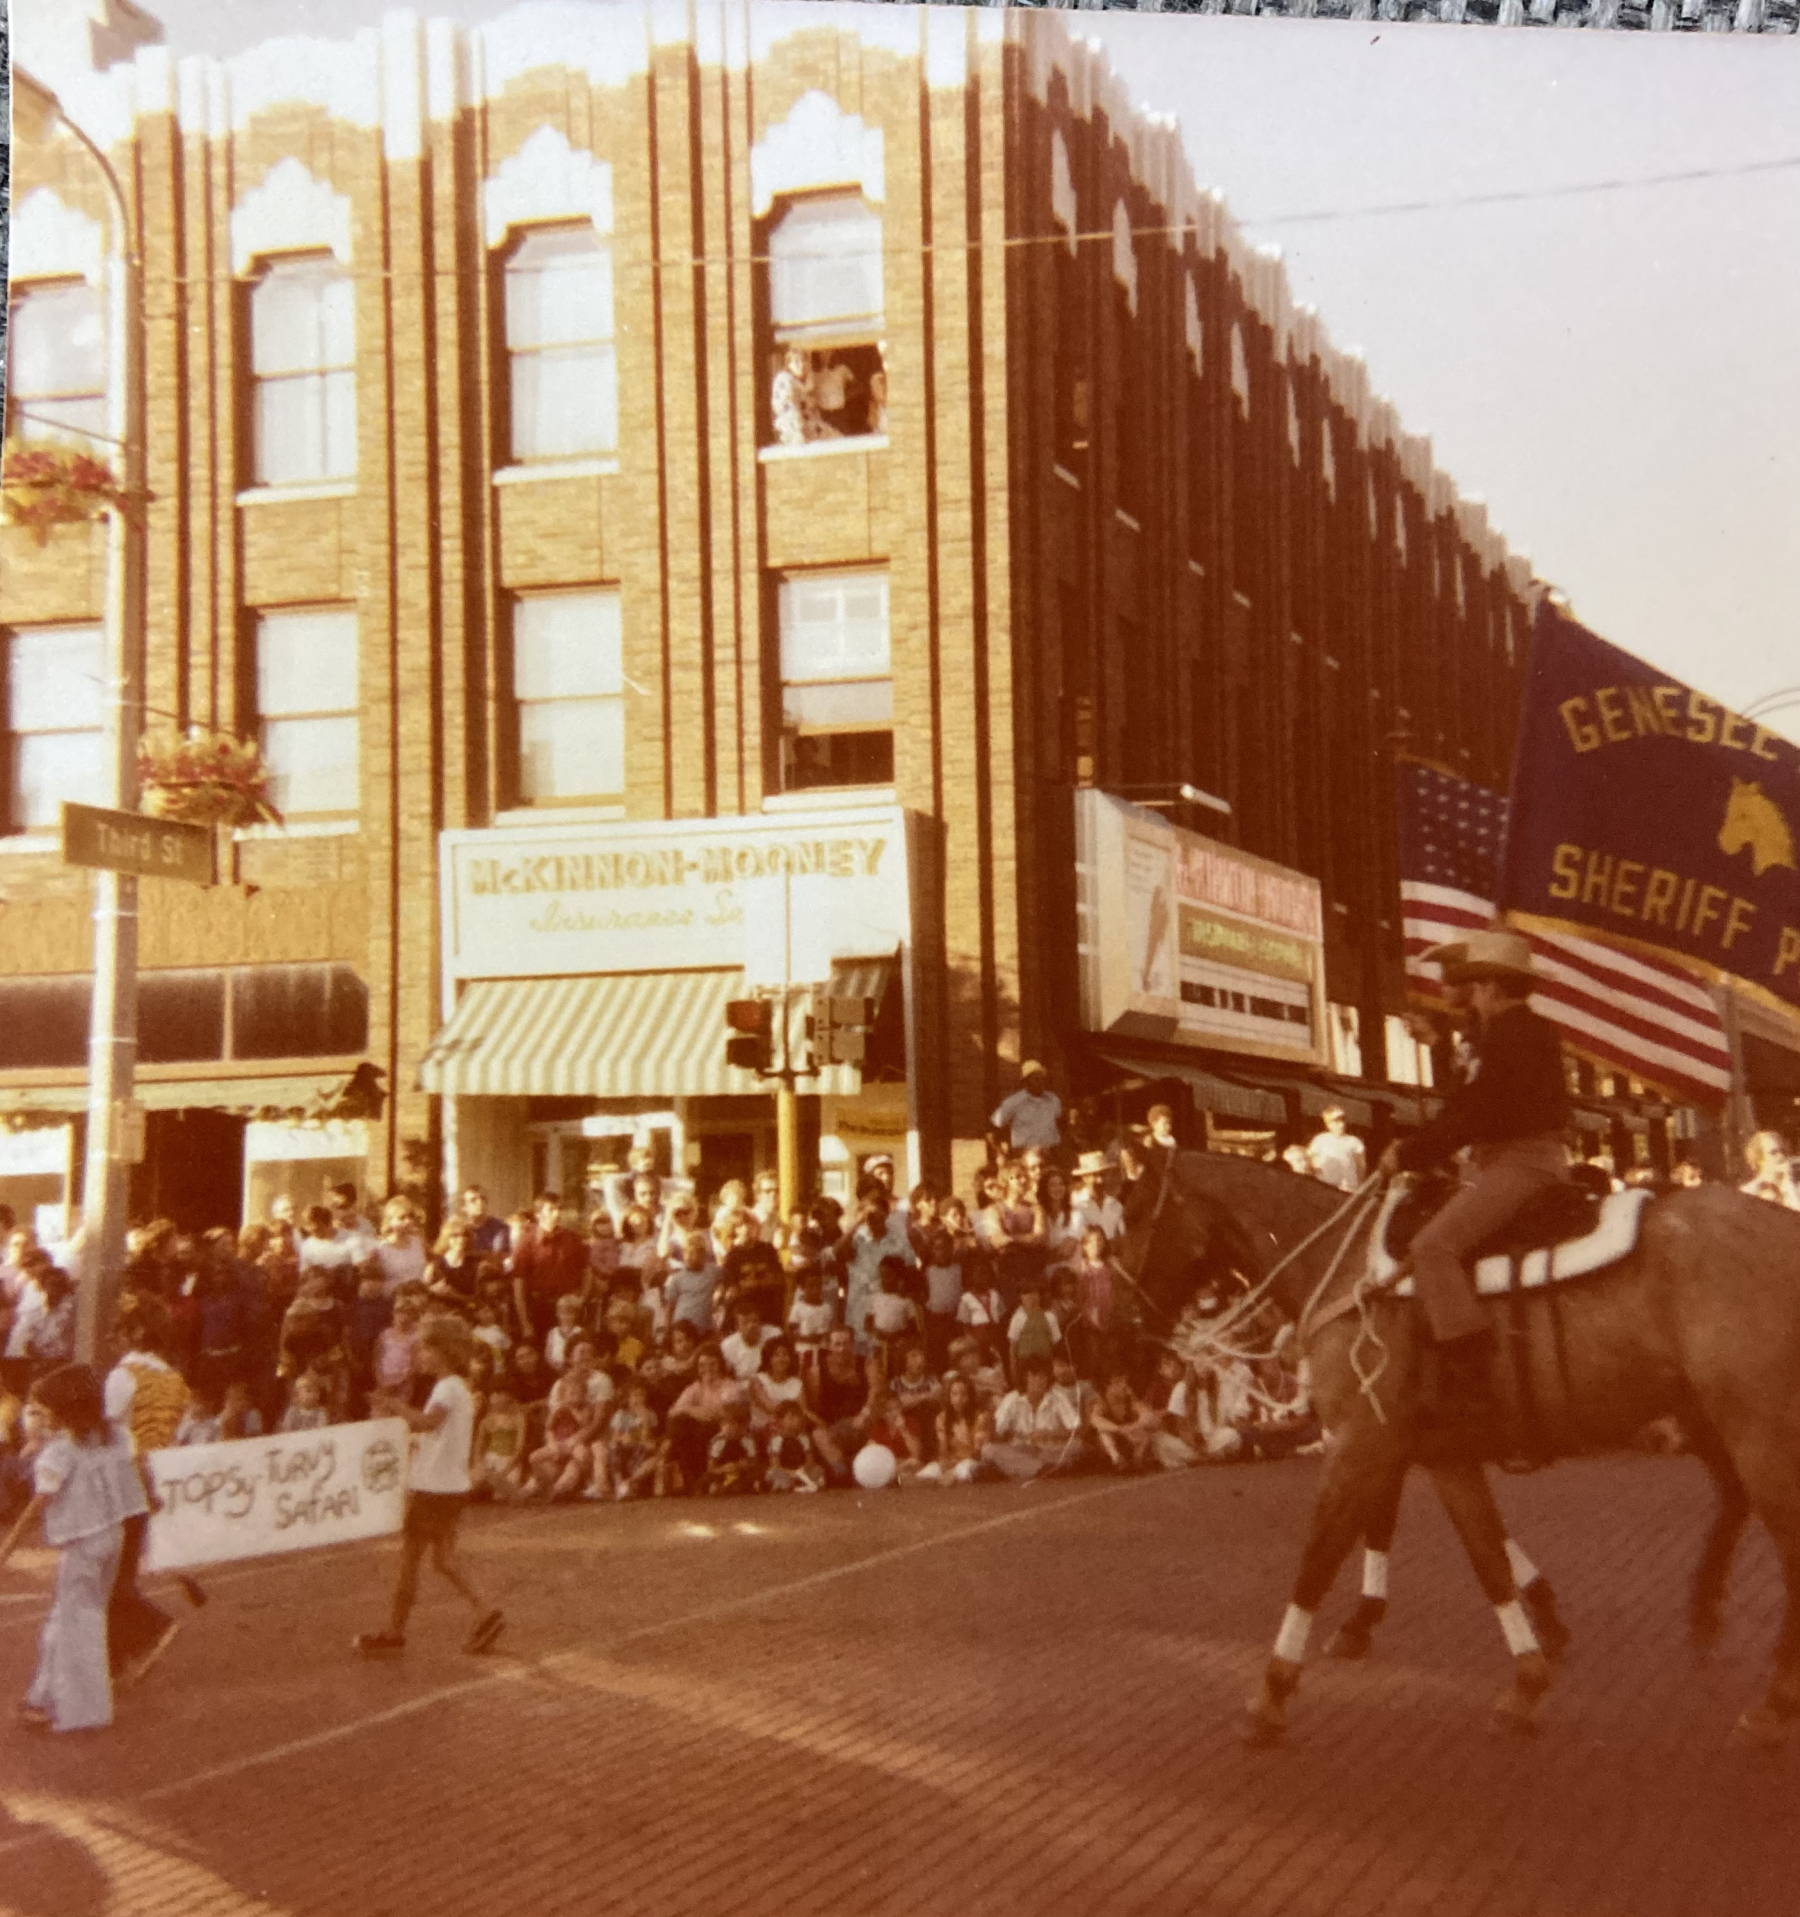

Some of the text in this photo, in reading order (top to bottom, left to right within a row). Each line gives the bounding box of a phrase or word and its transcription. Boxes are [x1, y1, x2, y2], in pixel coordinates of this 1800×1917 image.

[96, 822, 184, 866] Third St
[1549, 842, 1758, 949] SHERIFF
